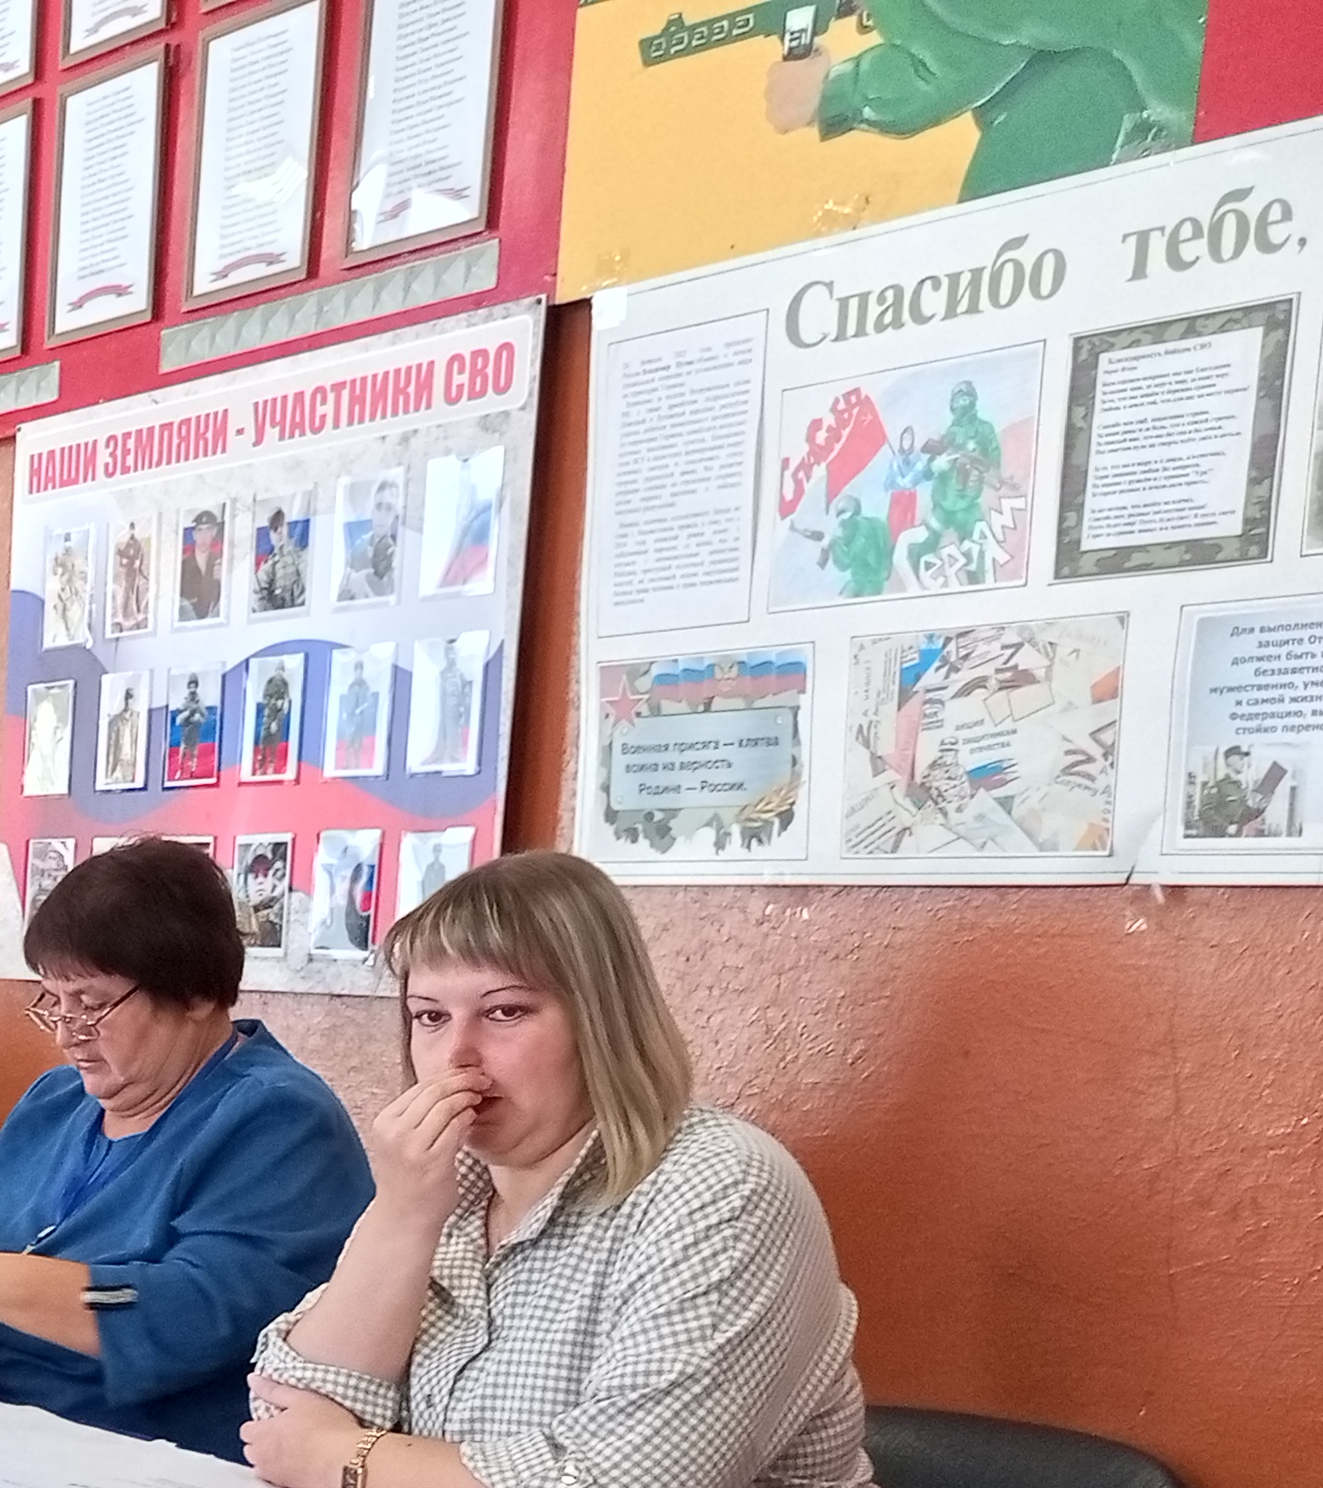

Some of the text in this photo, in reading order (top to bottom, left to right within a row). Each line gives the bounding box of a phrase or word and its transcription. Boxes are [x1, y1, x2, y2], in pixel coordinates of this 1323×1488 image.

[784, 185, 1308, 351] Спасибо тебе,
[28, 439, 97, 495] НАШИ
[103, 408, 228, 479] ЗЕМЛЯКИ
[252, 360, 435, 447] УЧАСТНИКИ
[443, 341, 515, 405] СВО
[1230, 626, 1255, 637] Для
[1256, 637, 1304, 648] защите
[1231, 650, 1317, 667] должен быть
[1246, 694, 1285, 706] самой
[1235, 724, 1278, 735] стойко
